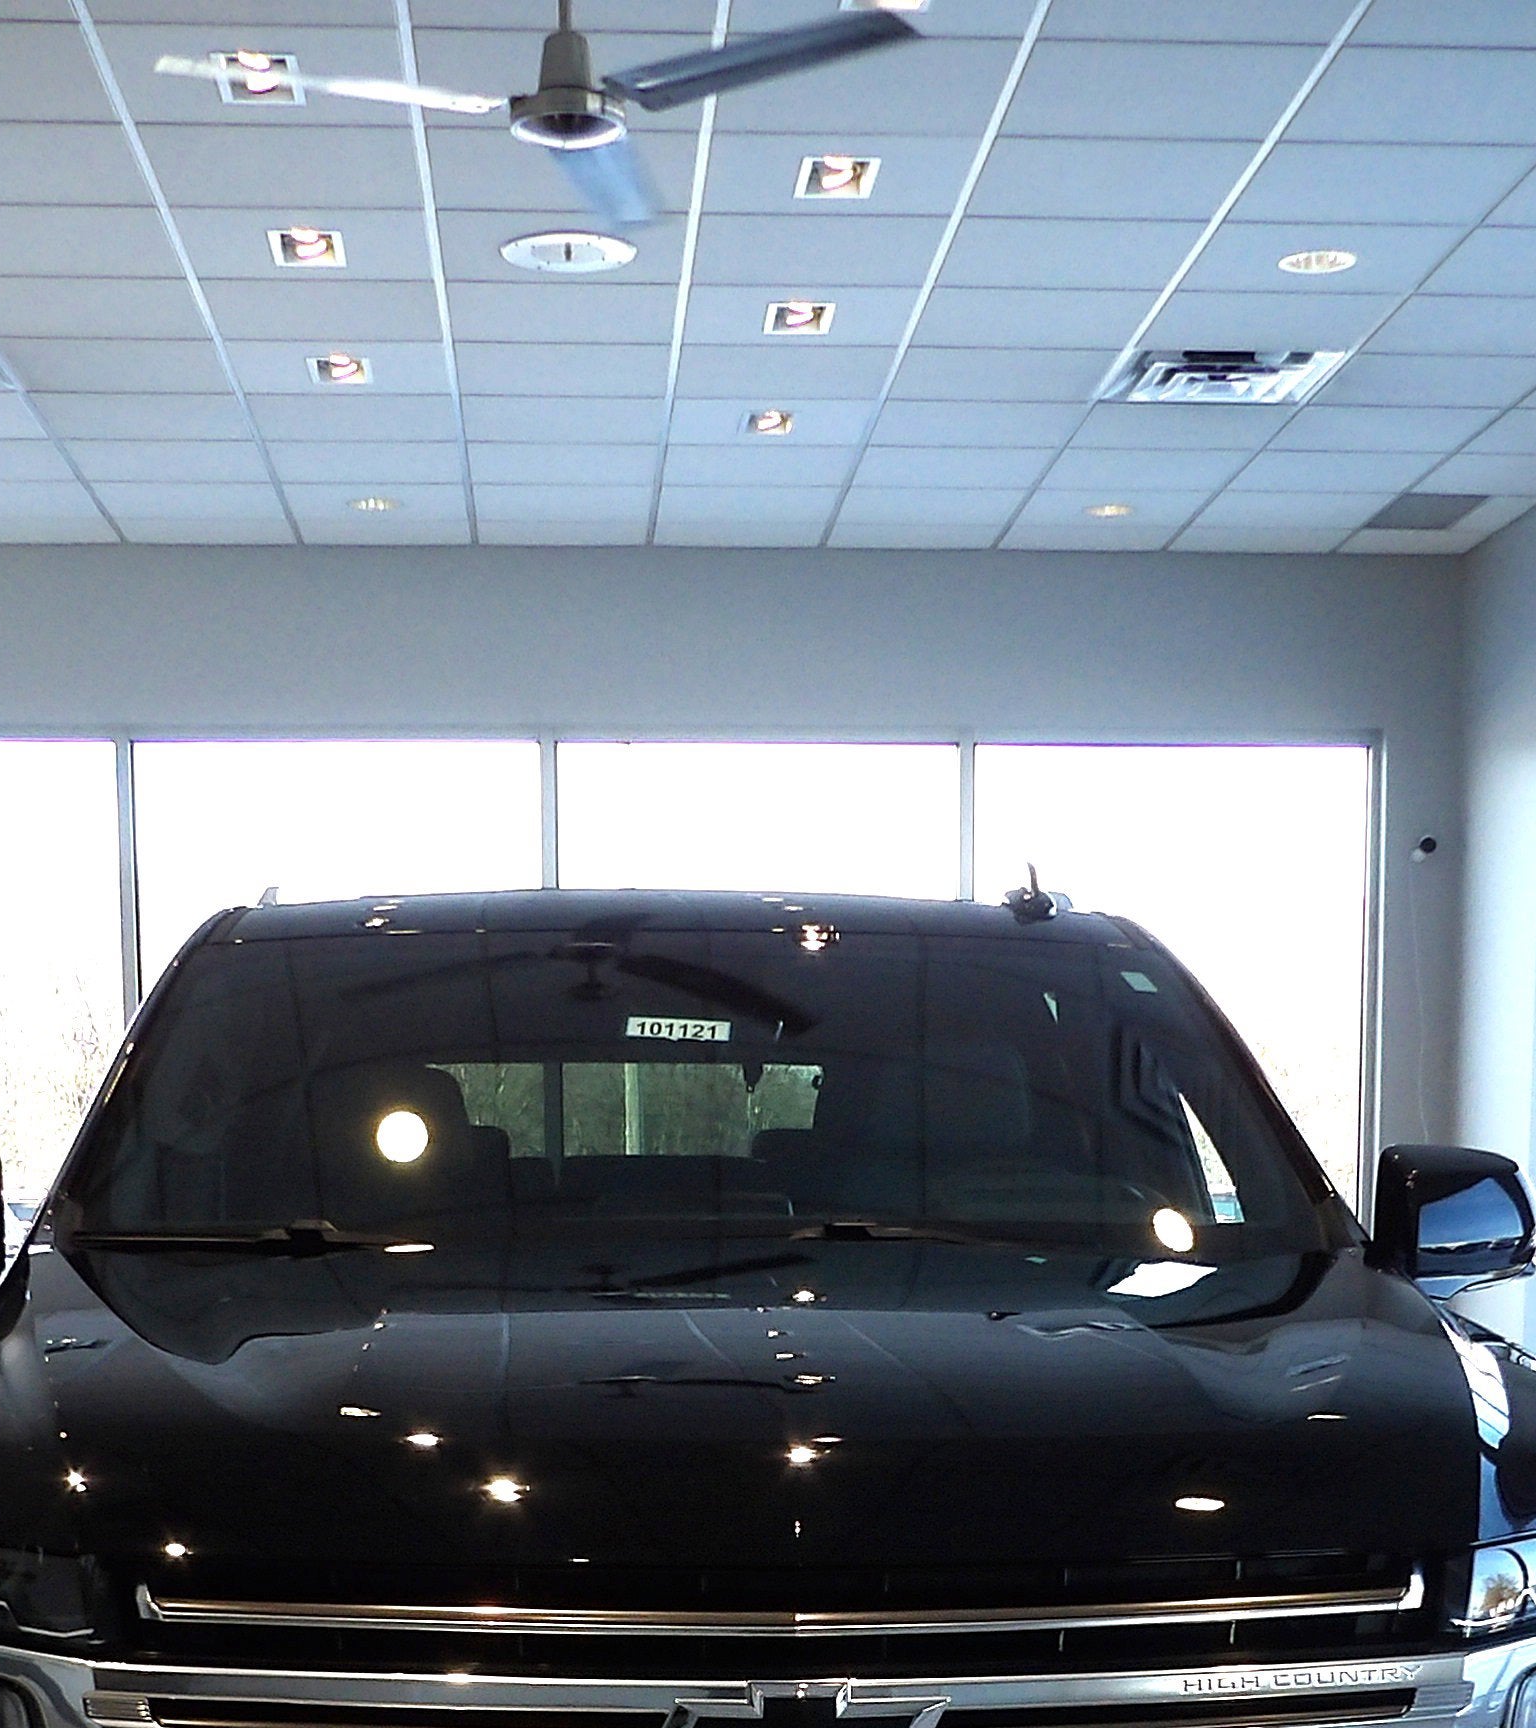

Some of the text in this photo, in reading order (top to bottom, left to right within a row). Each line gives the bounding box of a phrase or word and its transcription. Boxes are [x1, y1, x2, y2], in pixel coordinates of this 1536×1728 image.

[636, 1021, 718, 1039] 101121
[1182, 1664, 1424, 1693] HIGH COUNTRY
